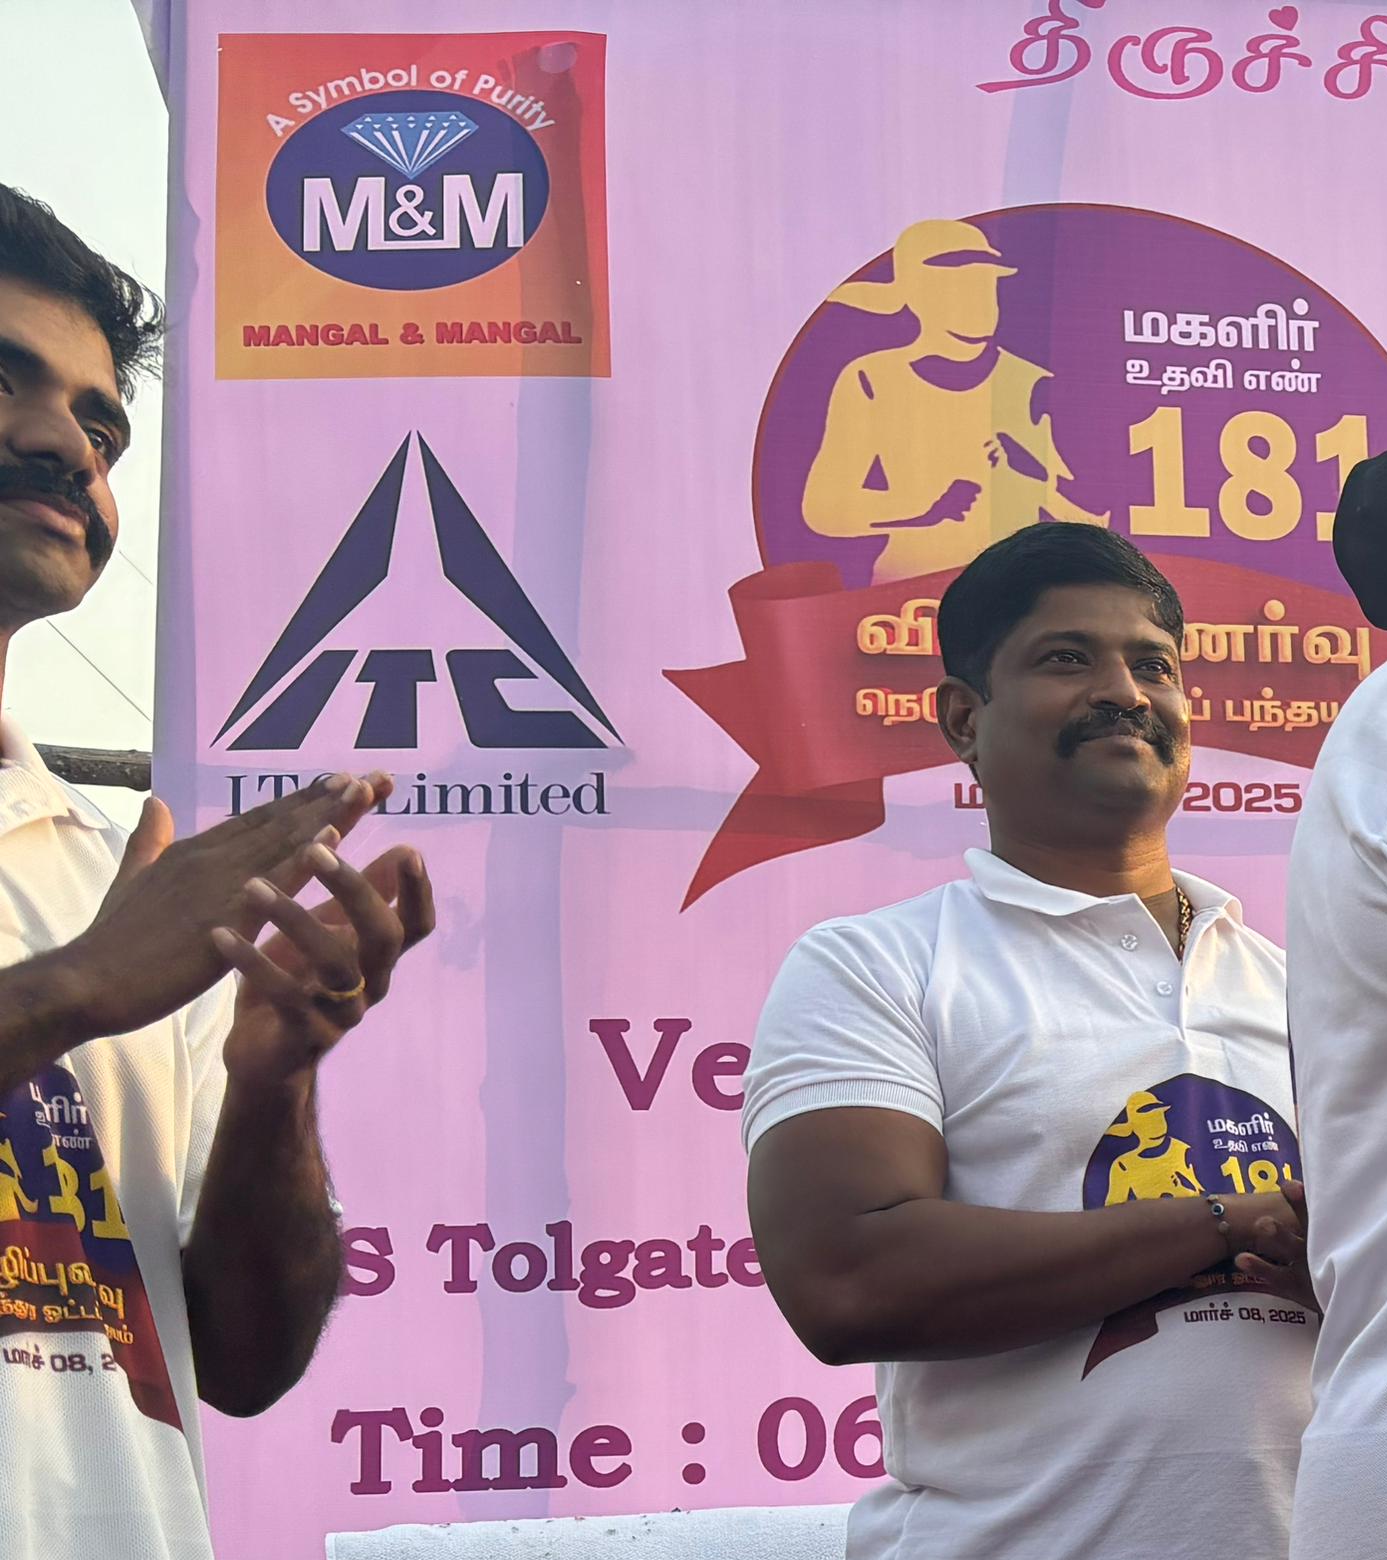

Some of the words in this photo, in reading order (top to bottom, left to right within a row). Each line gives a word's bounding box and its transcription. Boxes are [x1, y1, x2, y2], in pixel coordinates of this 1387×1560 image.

[266, 113, 295, 138] A
[288, 65, 417, 115] Symbol
[429, 69, 469, 91] of
[472, 73, 557, 132] Purity
[303, 172, 524, 252] M&M
[243, 323, 389, 347] MANGAL
[399, 322, 425, 345] &
[435, 321, 583, 344] MANGAL
[1123, 298, 1320, 352] மகளிர்
[1125, 357, 1234, 395] உதவி
[1243, 357, 1322, 393] எண்
[1128, 406, 1369, 541] 181
[226, 649, 609, 752] ITC
[371, 772, 612, 817] Limited
[1183, 782, 1303, 814] 2025
[1207, 1112, 1275, 1136] மகளிர்
[426, 1220, 766, 1310] Tolgate
[1183, 1302, 1233, 1323] மார்ச்
[1238, 1307, 1266, 1324] 08,
[1268, 1309, 1307, 1325] 2025
[50, 1354, 93, 1376] 08,
[330, 1406, 632, 1495] Time
[681, 1421, 707, 1484] :
